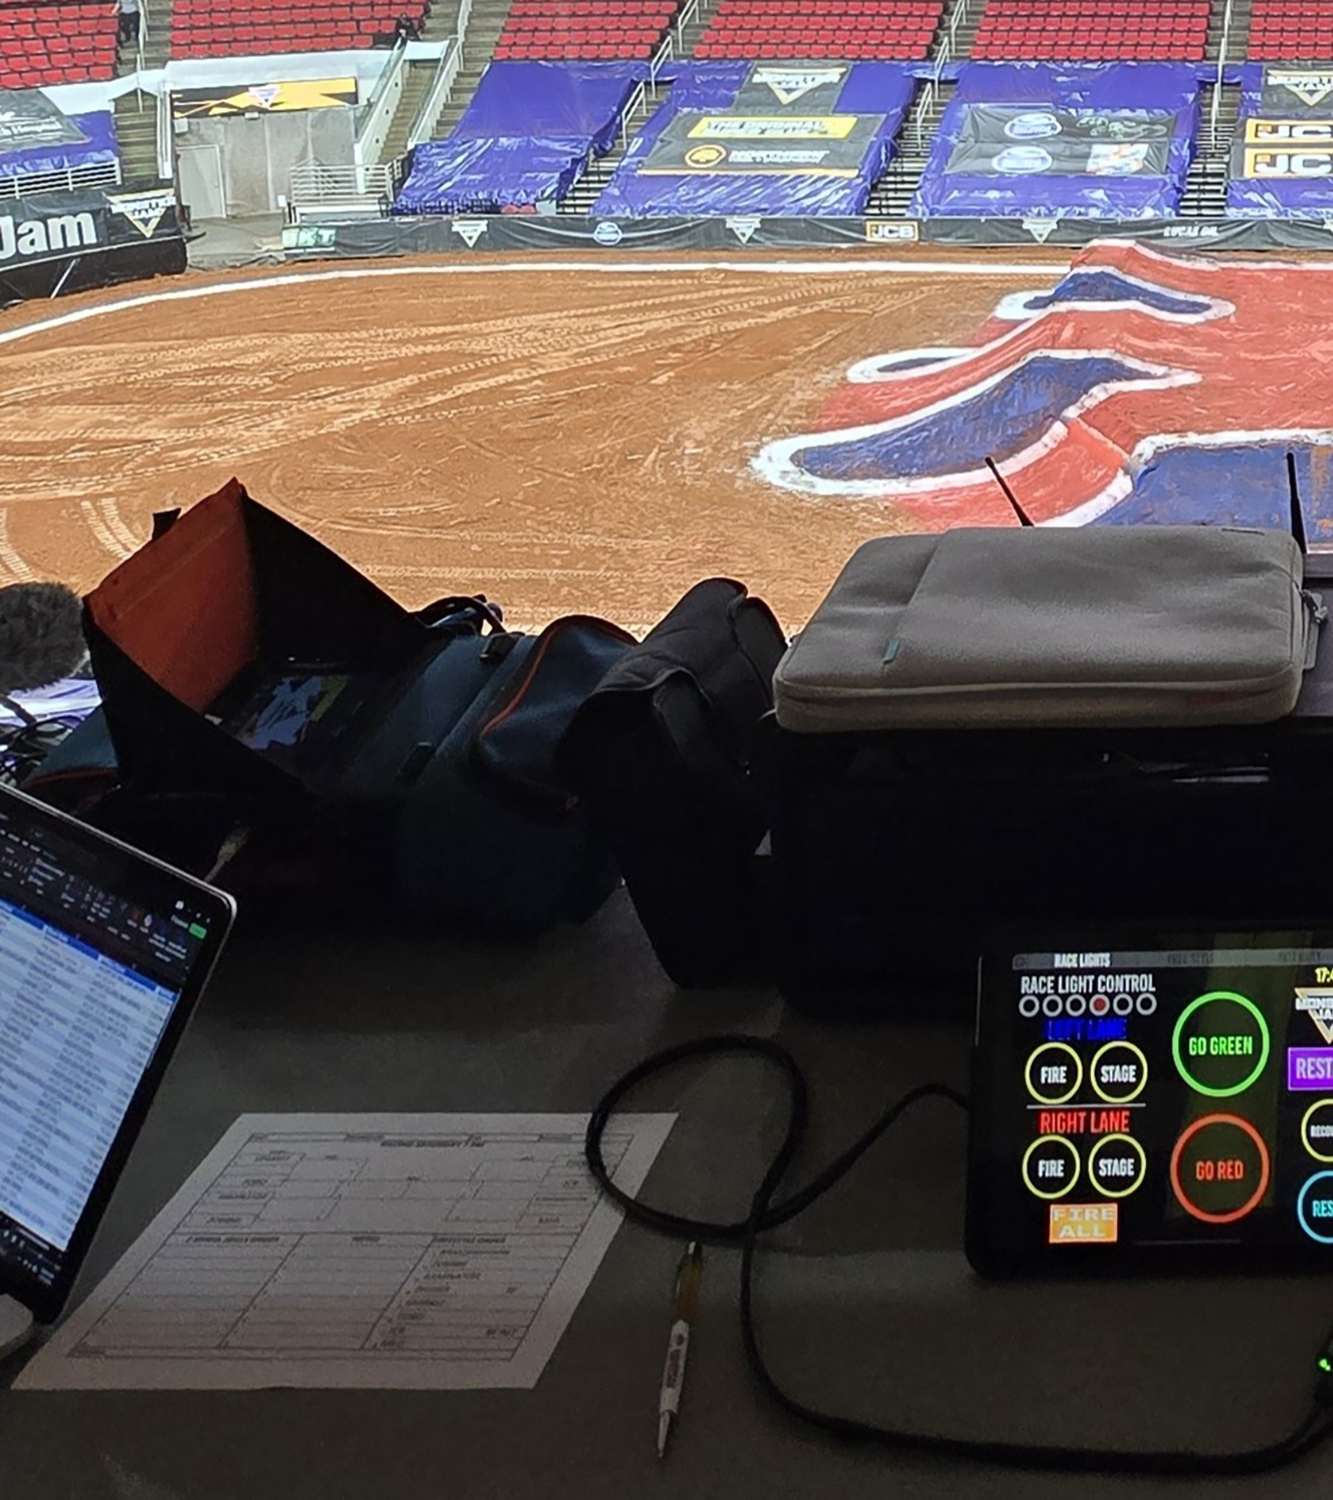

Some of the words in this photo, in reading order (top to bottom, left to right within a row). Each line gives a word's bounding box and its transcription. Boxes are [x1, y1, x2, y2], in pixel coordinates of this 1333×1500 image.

[0, 212, 97, 259] Jam
[869, 223, 916, 238] JCB
[1054, 953, 1077, 968] RACE
[1079, 952, 1111, 968] LIGHTS
[1021, 976, 1055, 994] RACE
[1057, 975, 1095, 993] LIGHT
[1097, 973, 1156, 992] CONTROL
[1188, 1037, 1207, 1056] GO
[1209, 1035, 1253, 1055] GREEN
[1040, 1065, 1067, 1085] FIRE
[1100, 1064, 1137, 1083] STAGE
[1040, 1112, 1087, 1134] RIGHT
[1090, 1110, 1130, 1133] LANE
[1038, 1159, 1065, 1178] FIRE
[1098, 1158, 1135, 1177] STAGE
[1195, 1161, 1214, 1181] GO
[1217, 1159, 1244, 1180] RED
[1053, 1207, 1114, 1221] FIRE
[1059, 1225, 1105, 1238] ALL
